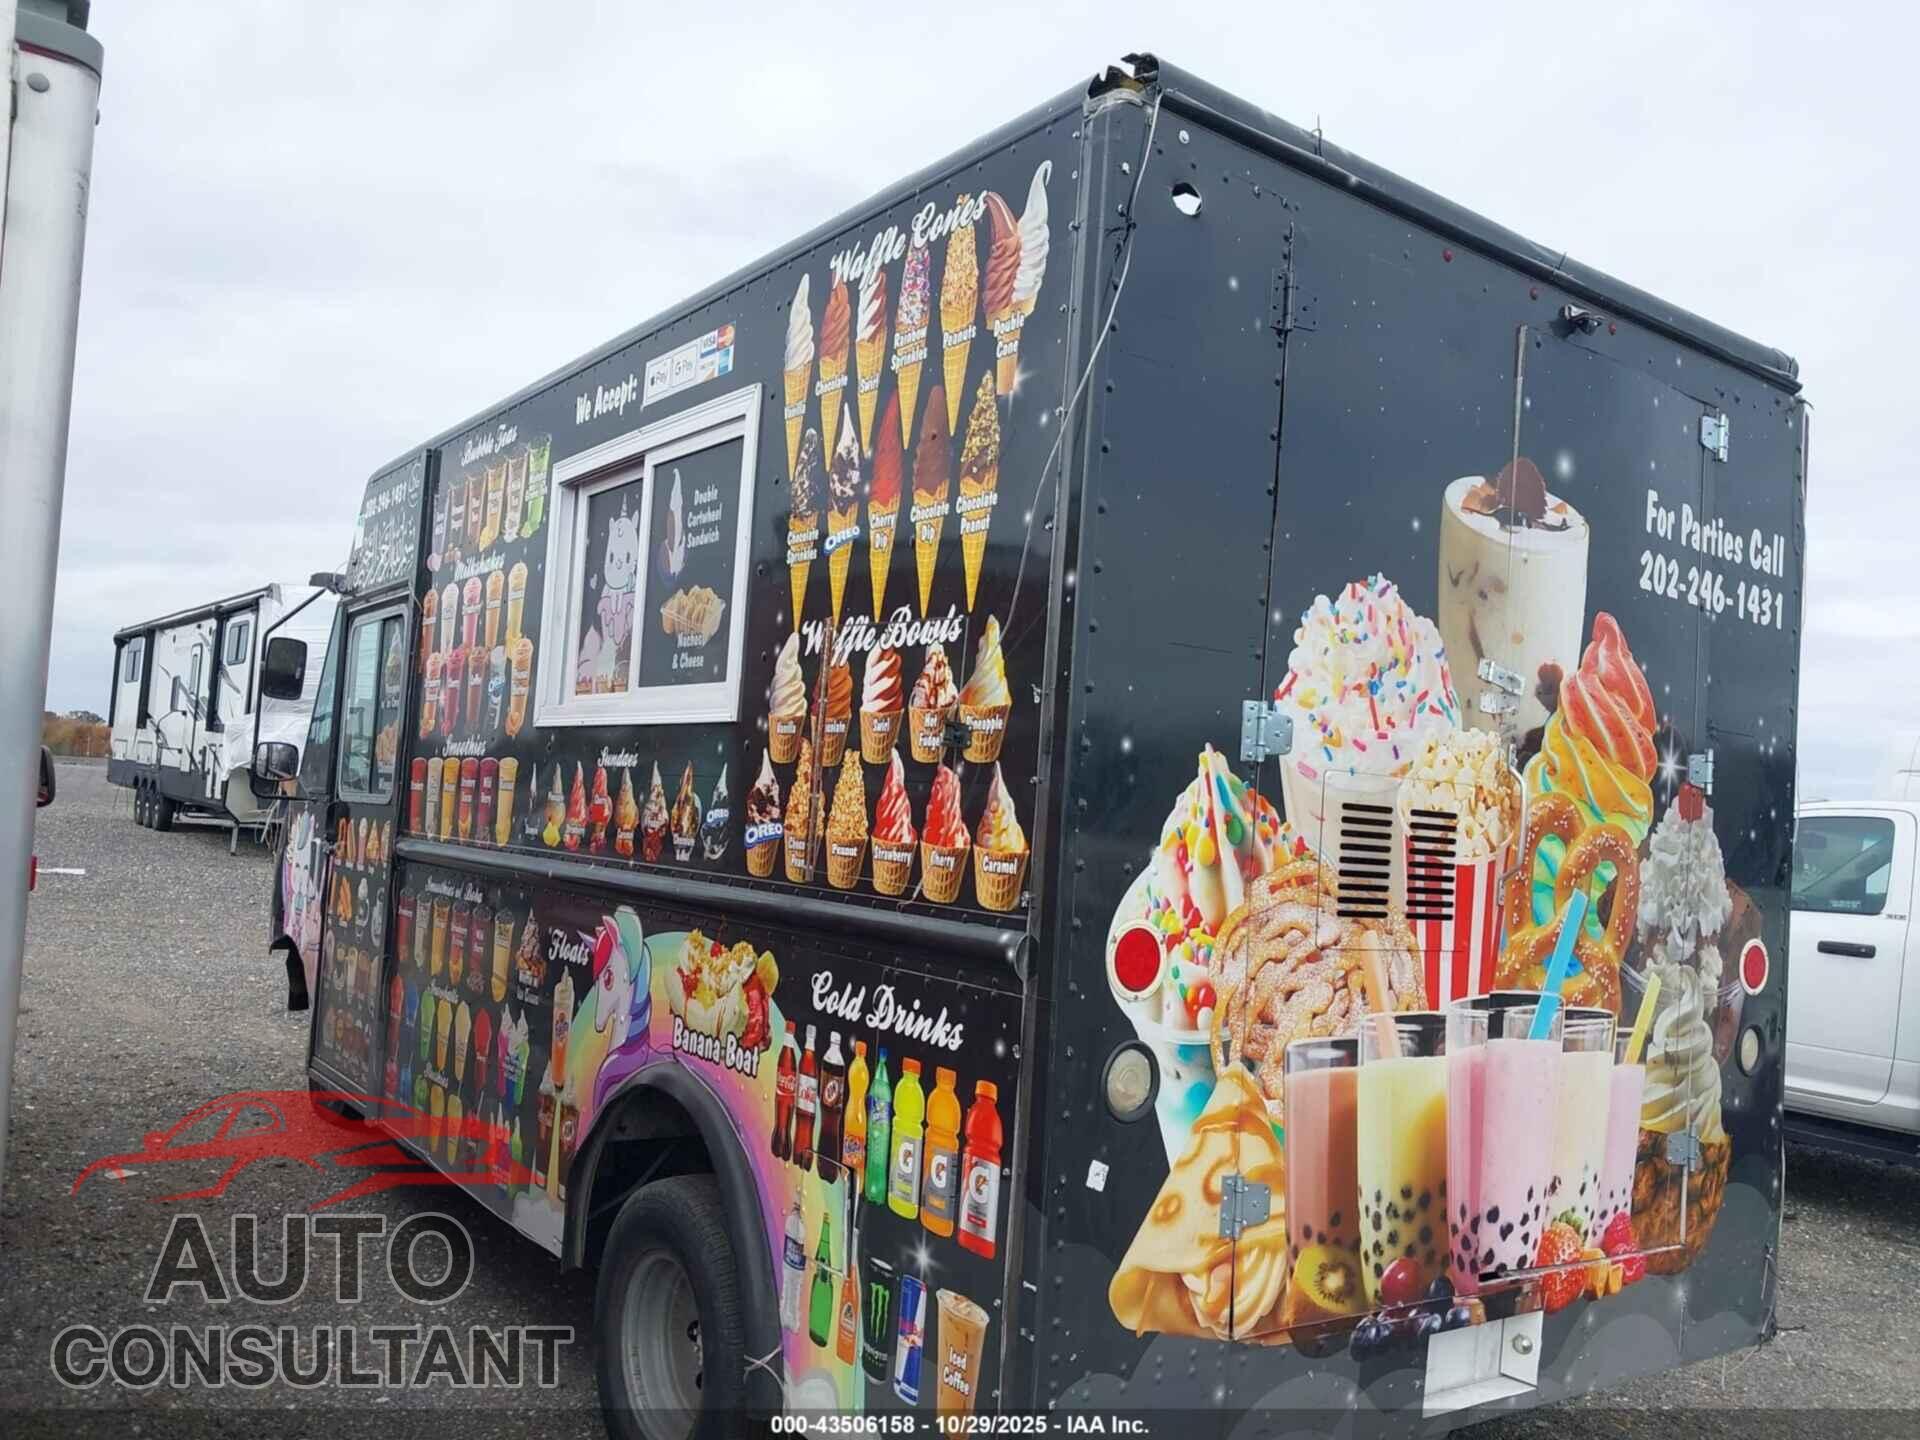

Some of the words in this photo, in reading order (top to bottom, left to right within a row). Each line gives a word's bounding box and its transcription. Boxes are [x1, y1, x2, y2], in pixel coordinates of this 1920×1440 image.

[830, 226, 906, 290] Waffle
[912, 190, 988, 248] Cones
[994, 311, 1025, 338] Double
[943, 325, 977, 349] Peanuts
[890, 345, 927, 373] Sprinkles
[576, 396, 592, 424] We
[594, 373, 639, 418] Accept:
[694, 485, 718, 506] Double
[956, 491, 998, 514] Chocolate
[910, 501, 950, 523] Chocolate
[921, 523, 935, 546] Dip
[960, 515, 990, 535] Peanut
[1646, 489, 1676, 541] For
[1681, 503, 1744, 565] Parties
[1749, 528, 1785, 578] Call
[687, 527, 720, 549] Sandwich
[1639, 550, 1784, 630] 202-246-1431
[801, 614, 876, 667] Wffle
[880, 604, 963, 650] Bowls
[679, 653, 705, 668] Cheese
[924, 714, 938, 727] Hot
[597, 745, 640, 768] Sundaes
[744, 822, 784, 844] OREO
[831, 843, 858, 857] Peanut
[872, 844, 913, 866] Strawberry
[930, 850, 955, 871] Cherry
[982, 854, 1018, 876] Caramel
[549, 928, 590, 966] Floats
[811, 970, 866, 1021] Cold
[866, 984, 964, 1052] Drinks
[948, 1345, 968, 1370] Iced
[943, 1366, 970, 1396] Coffee
